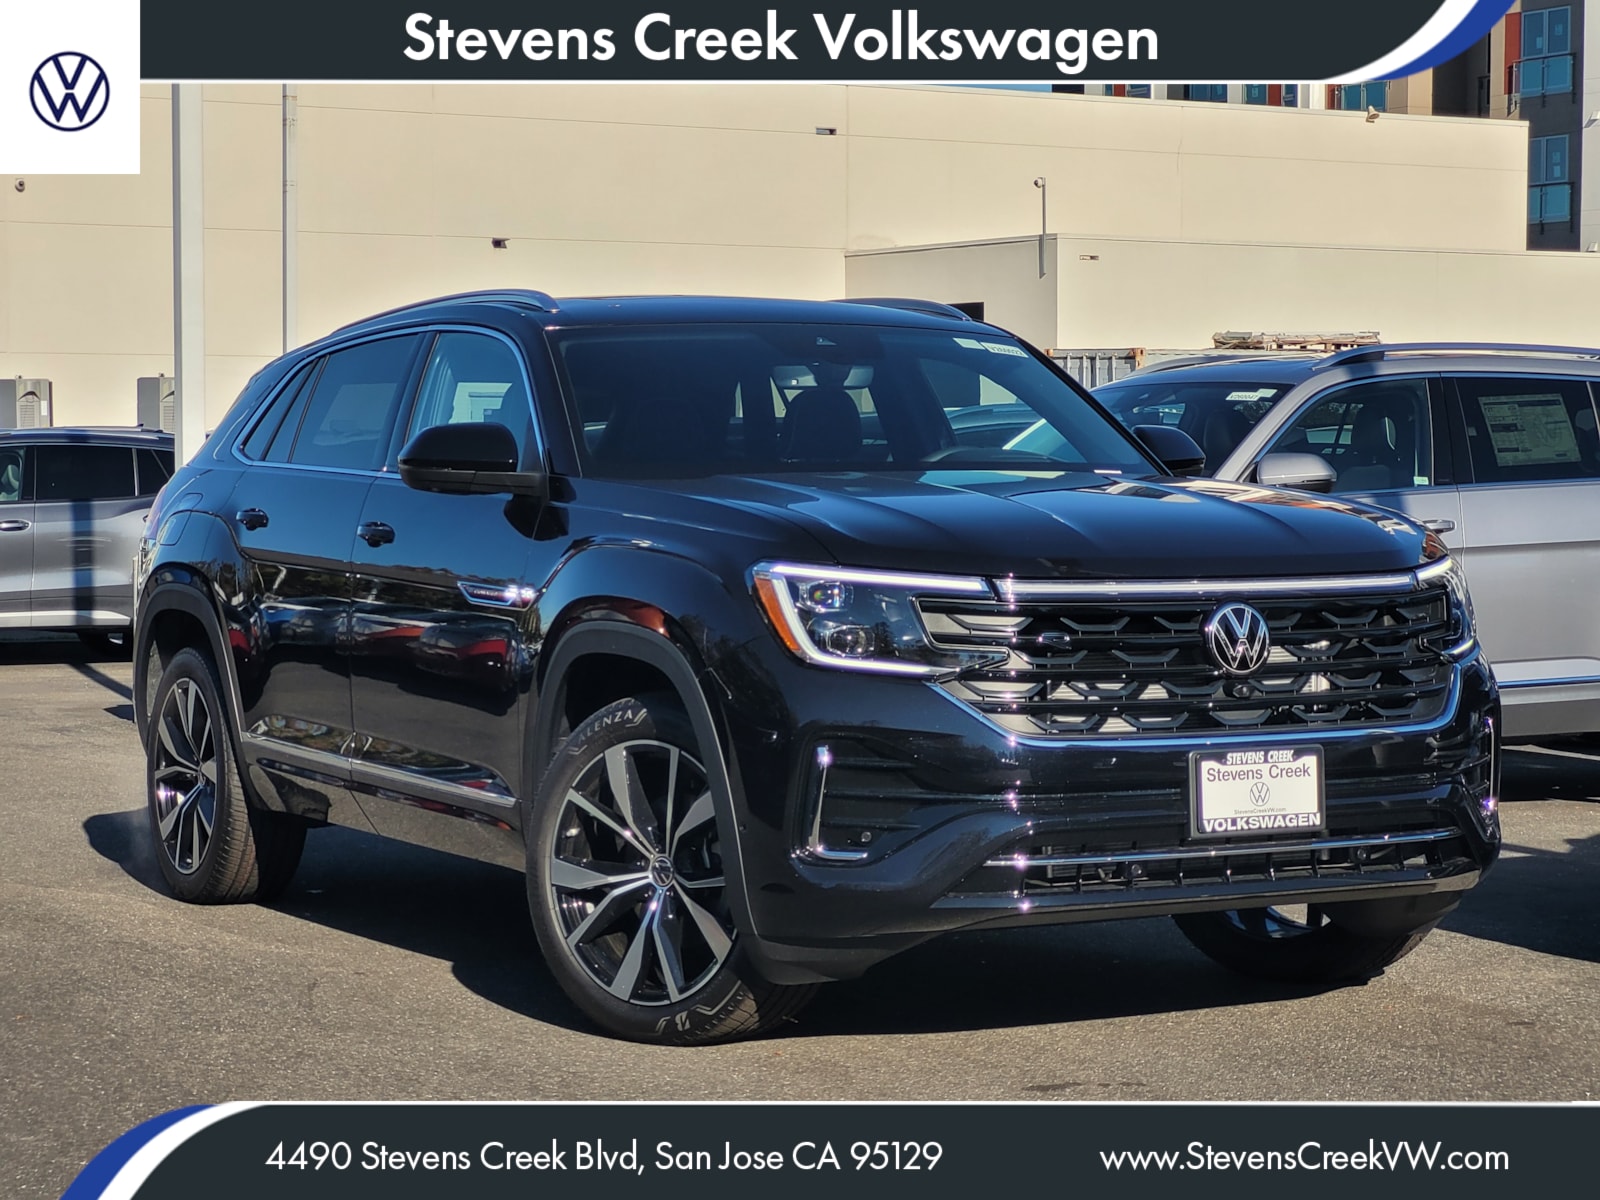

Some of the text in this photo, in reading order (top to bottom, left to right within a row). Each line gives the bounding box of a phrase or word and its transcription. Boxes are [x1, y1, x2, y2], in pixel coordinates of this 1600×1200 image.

[1226, 749, 1294, 765] STEVENS CREEK
[1206, 763, 1311, 782] Stevens Creek
[1203, 813, 1321, 833] VOLKSWAGEN
